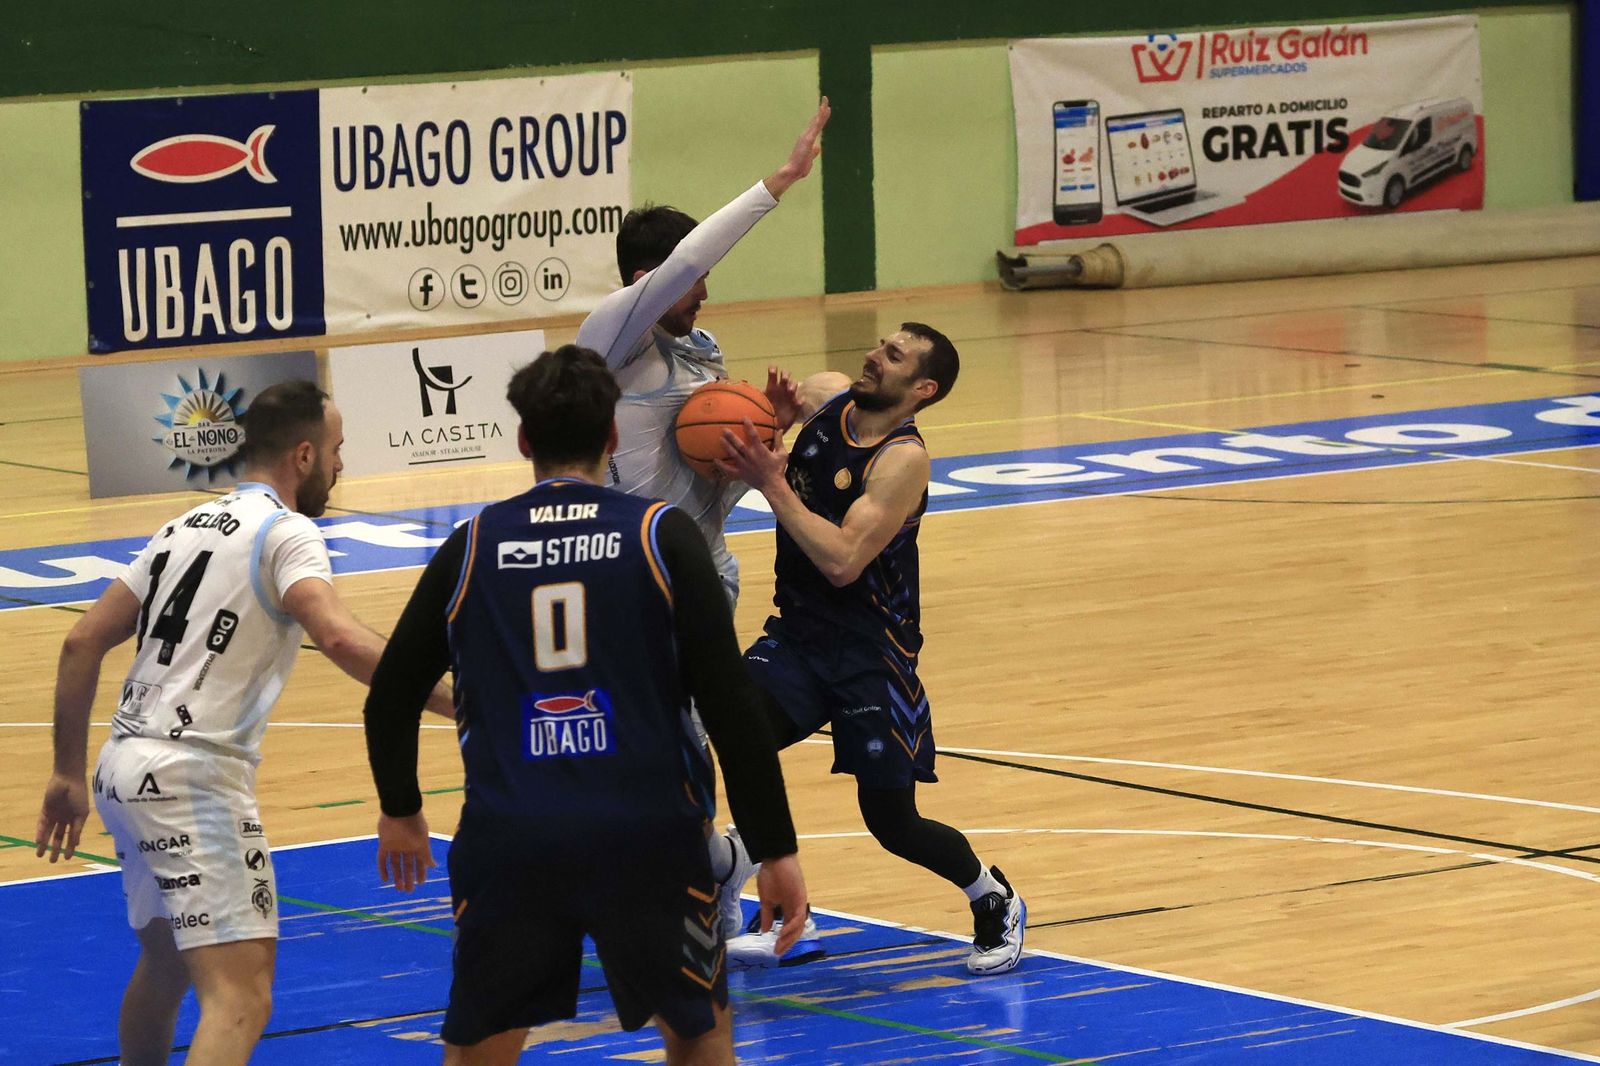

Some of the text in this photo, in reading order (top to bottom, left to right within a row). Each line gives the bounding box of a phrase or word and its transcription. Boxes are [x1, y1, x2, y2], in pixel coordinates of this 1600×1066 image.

[1211, 26, 1368, 65] Ruiz Galán
[1210, 62, 1308, 79] SUPERMERCADOS
[1202, 98, 1348, 119] REPARTO A DOMICILIO
[331, 109, 627, 193] UBAGO GROUP
[1202, 117, 1349, 162] GRATIS
[340, 202, 622, 254] www.ubagogroup.com
[117, 236, 294, 343] UBAGO
[174, 428, 238, 448] EL NONO
[389, 422, 502, 447] LA CASITA
[529, 503, 600, 524] VALOR
[545, 532, 622, 566] STROG
[136, 550, 214, 667] 14
[530, 580, 588, 673] 0
[530, 717, 608, 757] UBAGO
